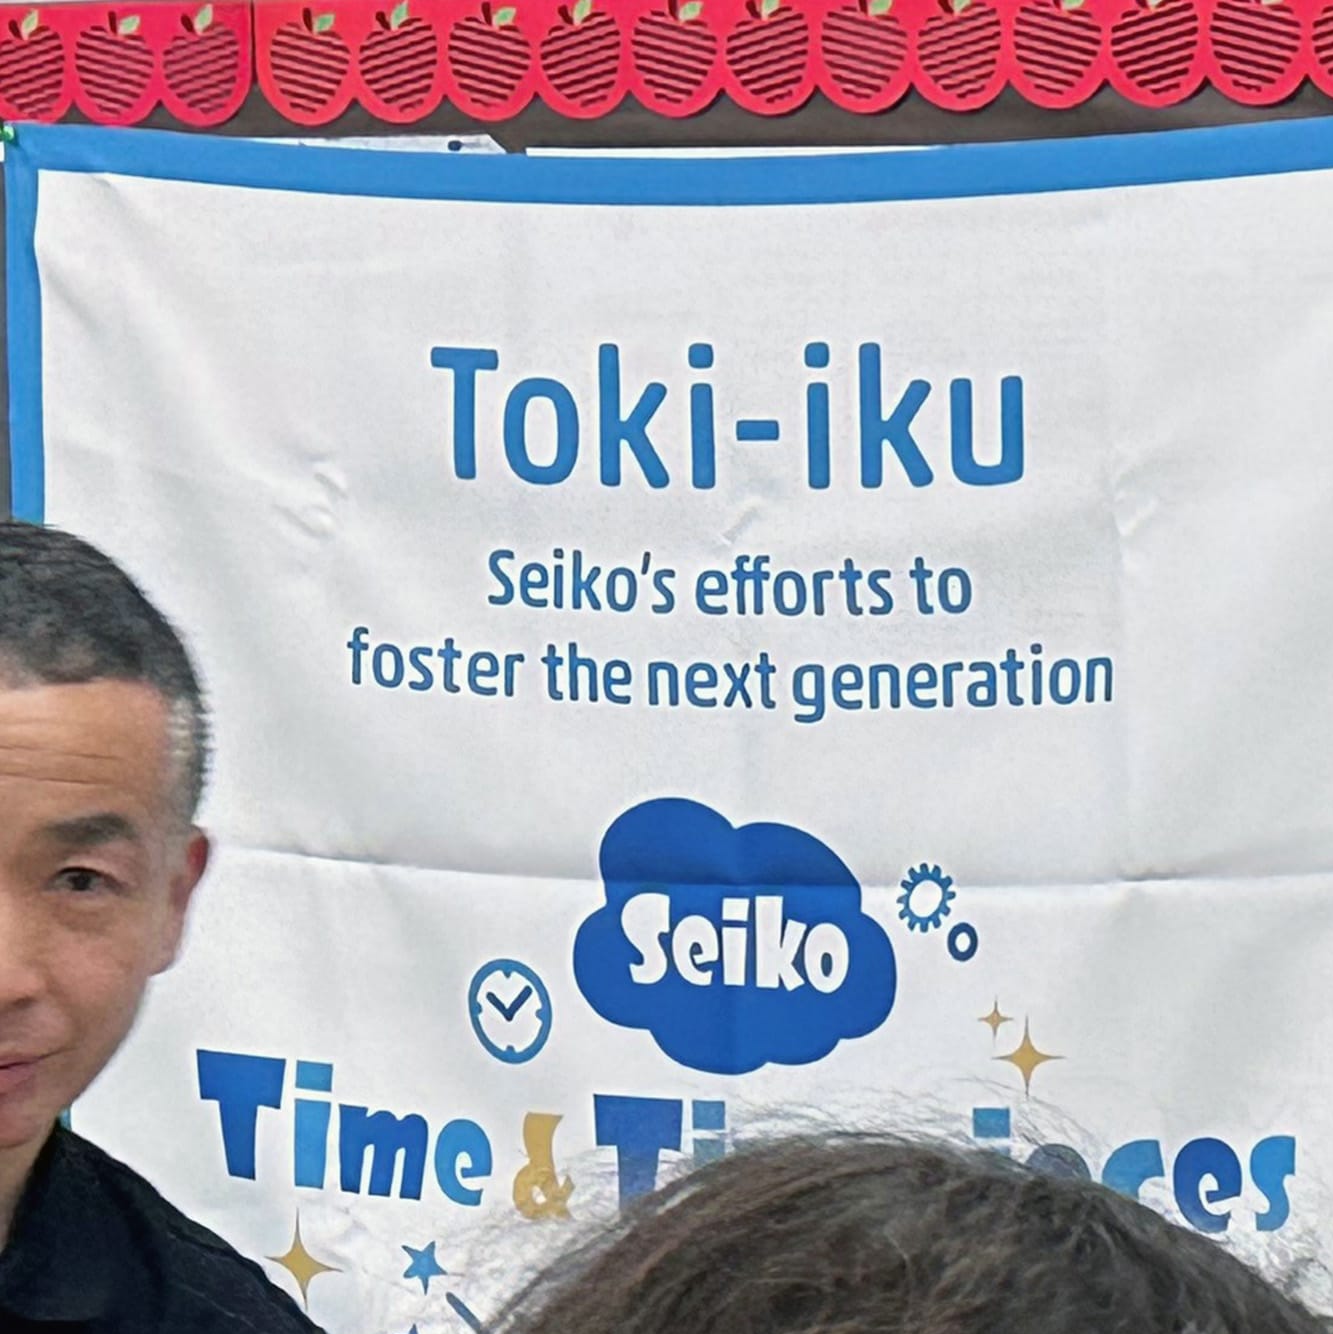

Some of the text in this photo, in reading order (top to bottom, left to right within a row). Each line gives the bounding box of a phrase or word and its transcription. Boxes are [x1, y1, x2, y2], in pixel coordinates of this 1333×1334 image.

[430, 342, 1024, 490] Toki-iku
[487, 549, 972, 616] Seiko's efforts to
[347, 627, 1113, 723] foster the next generation
[627, 895, 851, 994] Seiko
[196, 1048, 494, 1206] Time
[512, 1110, 573, 1221] &
